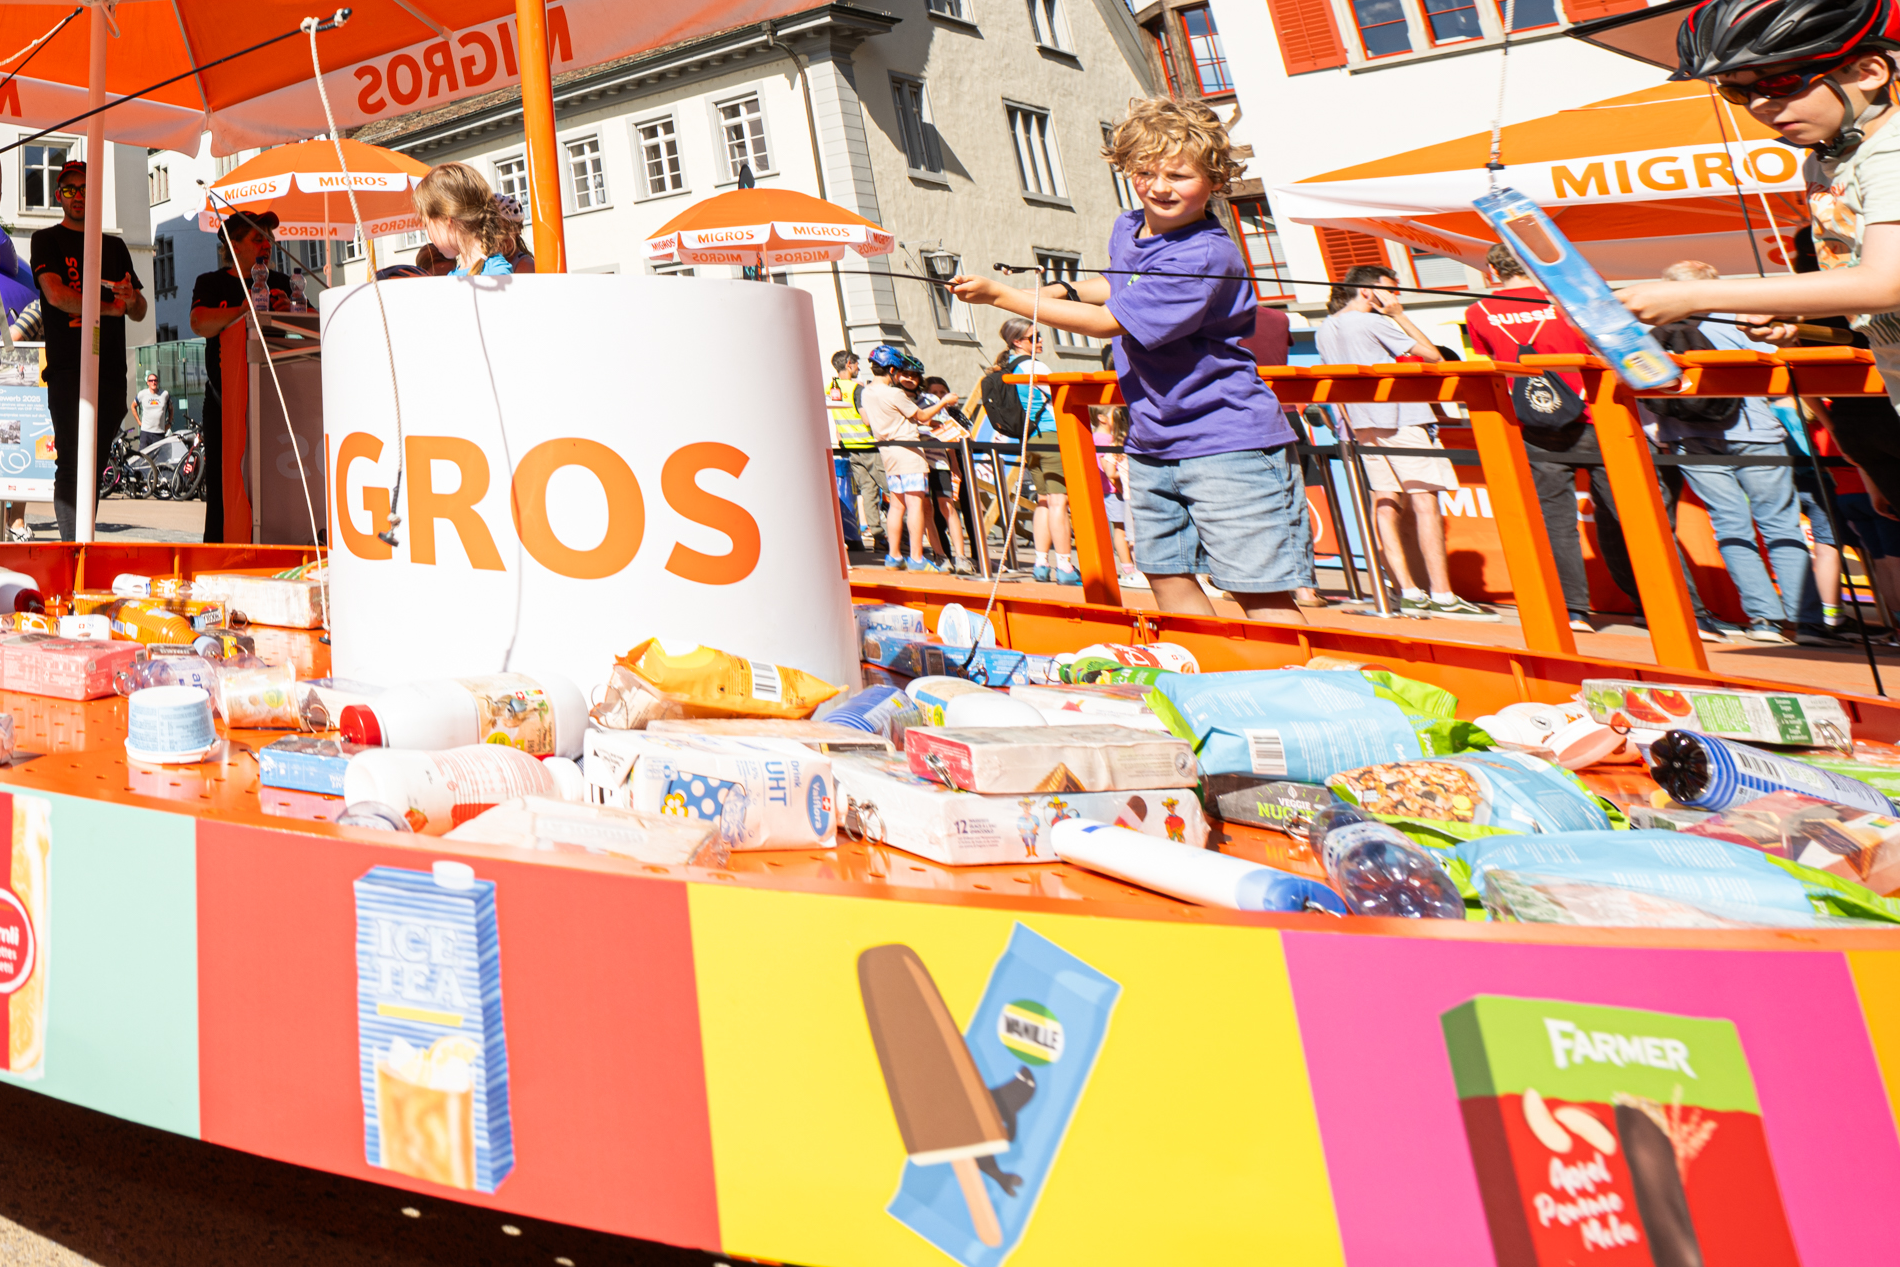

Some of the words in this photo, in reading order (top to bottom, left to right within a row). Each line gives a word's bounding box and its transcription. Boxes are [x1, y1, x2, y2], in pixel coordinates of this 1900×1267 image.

[318, 176, 388, 187] MIGROS
[1552, 147, 1812, 198] MIGRO
[224, 181, 277, 201] MIGROS
[698, 230, 755, 244] MIGROS
[793, 226, 850, 237] MIGROS
[1488, 306, 1557, 326] SUISSE
[765, 761, 787, 806] UHT
[1277, 797, 1311, 810] VEGGIE
[954, 819, 968, 834] 12
[375, 918, 459, 967] ICE
[369, 955, 470, 1009] TEA
[1004, 1015, 1058, 1052] VANILLE
[1543, 1017, 1698, 1080] FARMER
